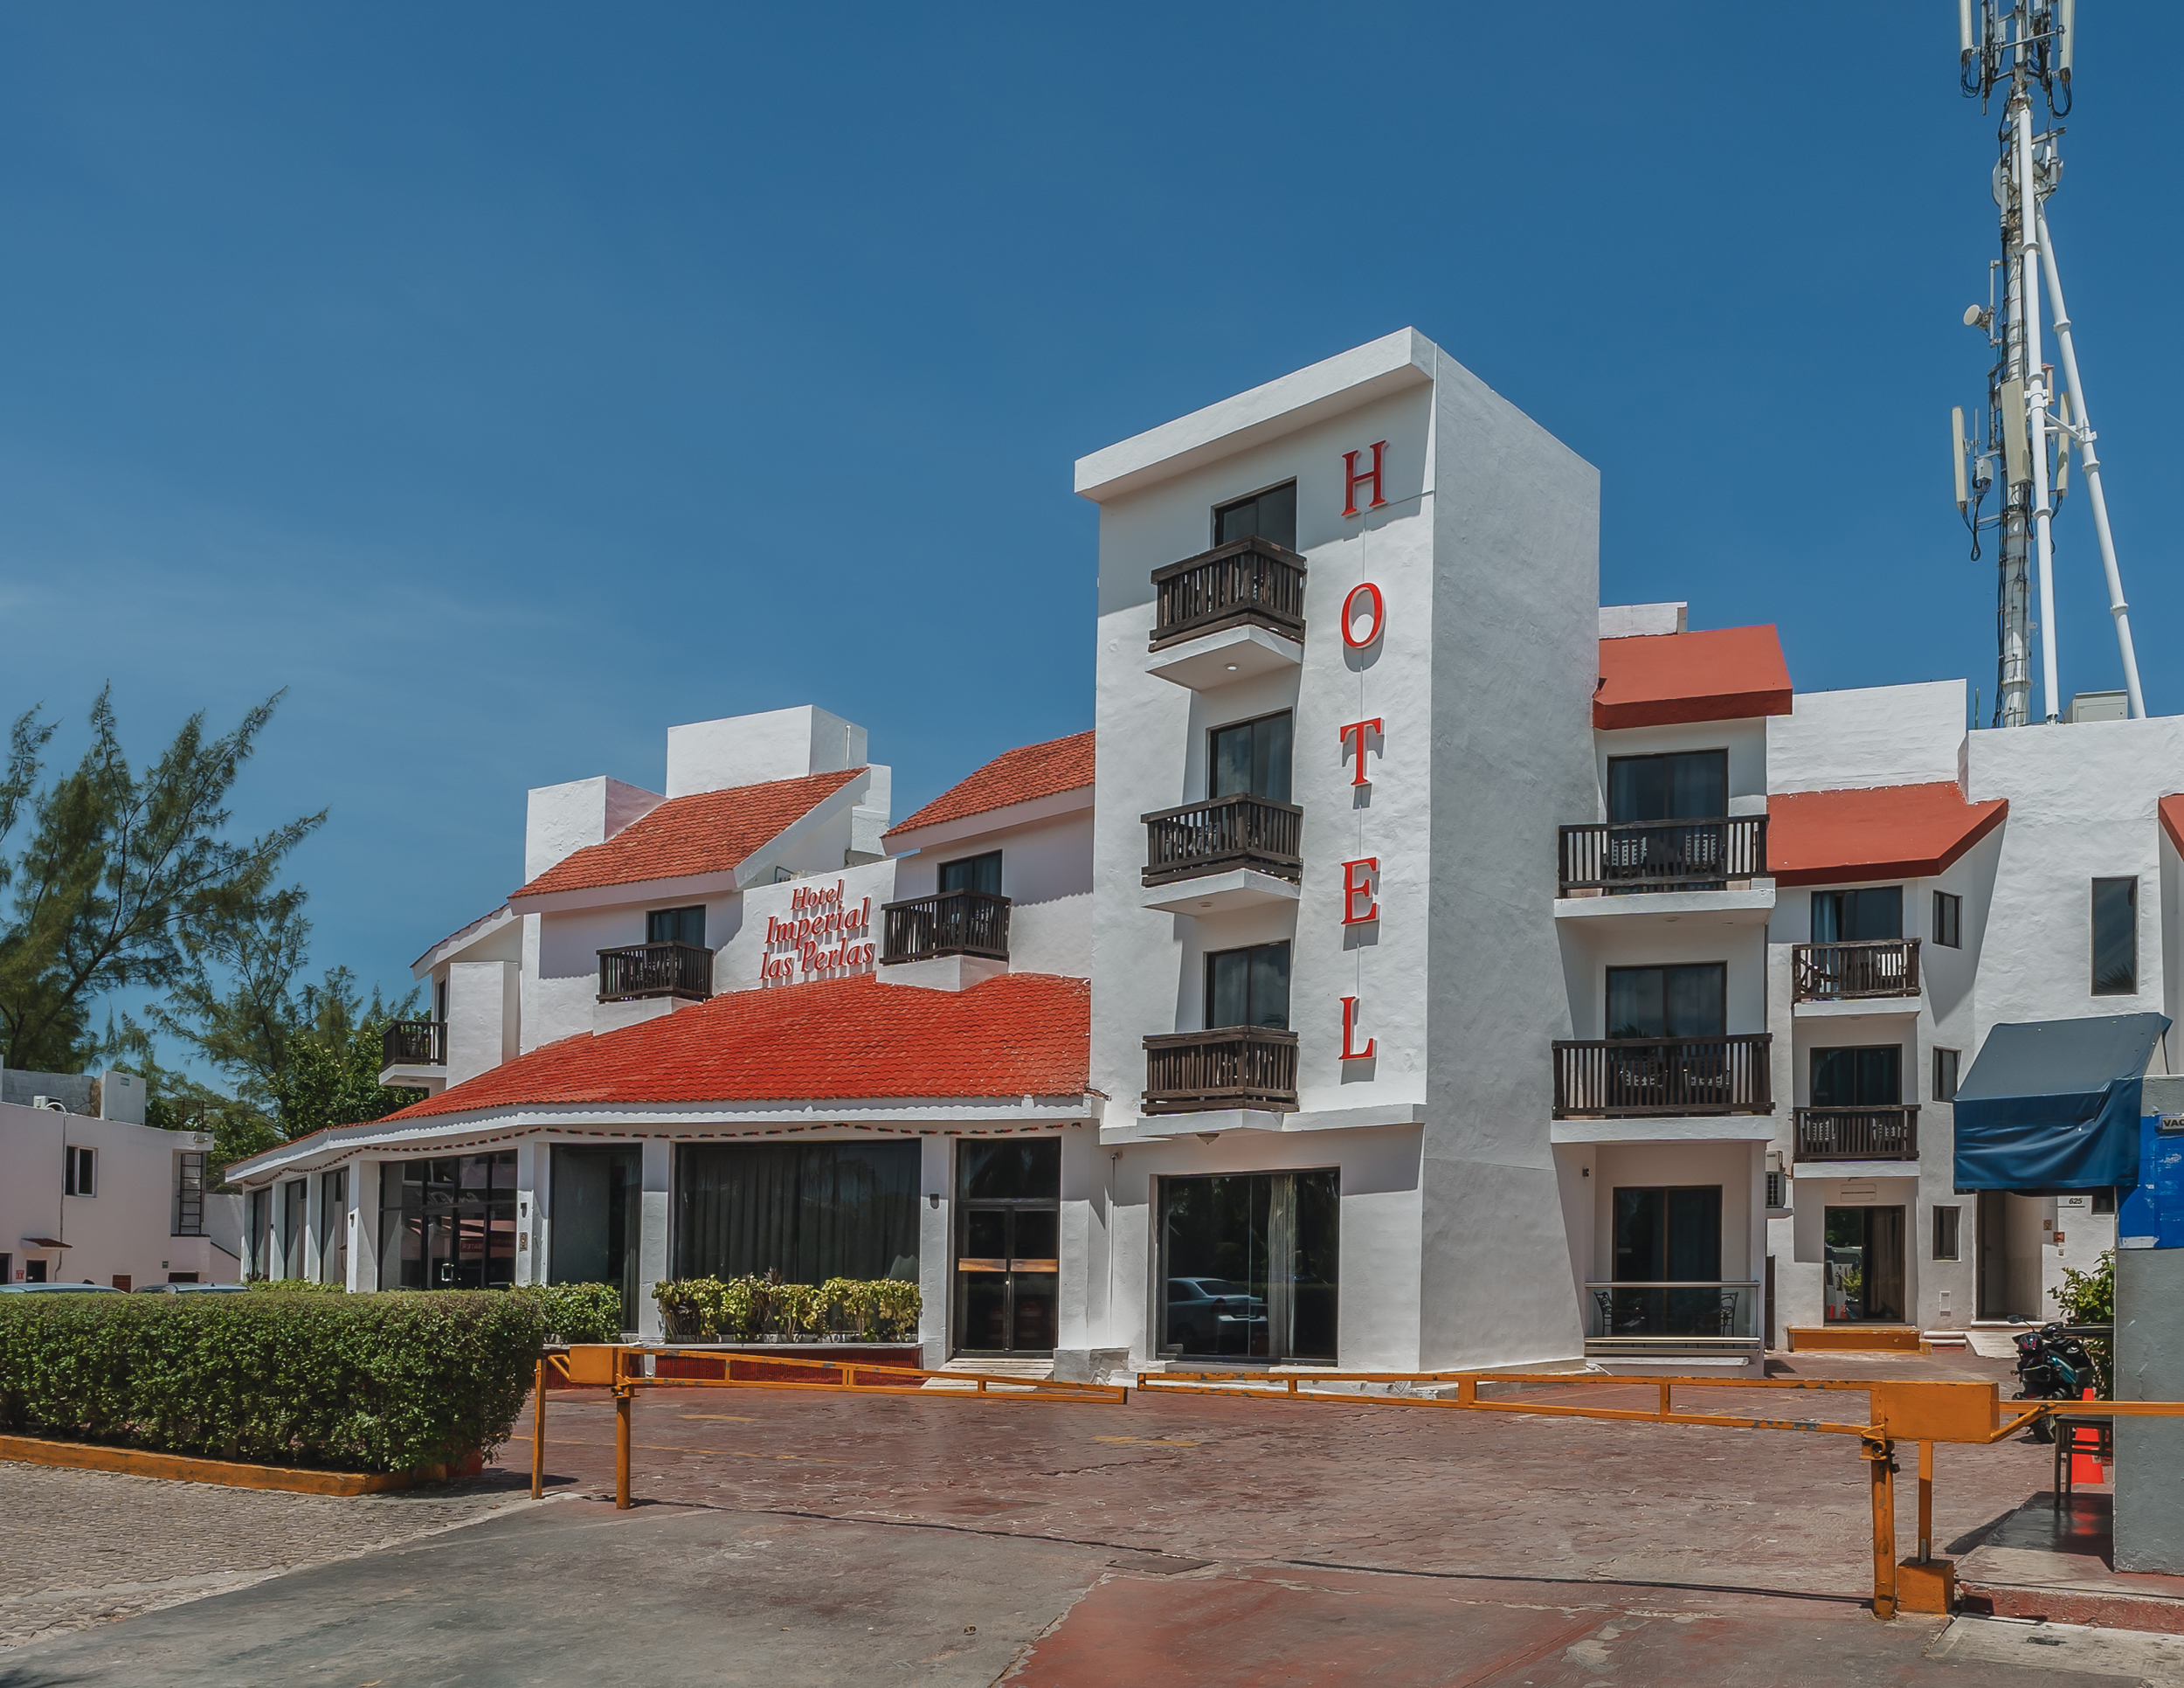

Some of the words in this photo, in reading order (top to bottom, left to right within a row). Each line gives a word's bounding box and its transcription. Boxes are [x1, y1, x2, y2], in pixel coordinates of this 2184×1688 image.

[1338, 439, 1387, 1061] HOTEL
[790, 878, 844, 910] Hotel
[764, 896, 870, 951] Imperial
[758, 951, 793, 980] las
[801, 937, 874, 972] Perlas
